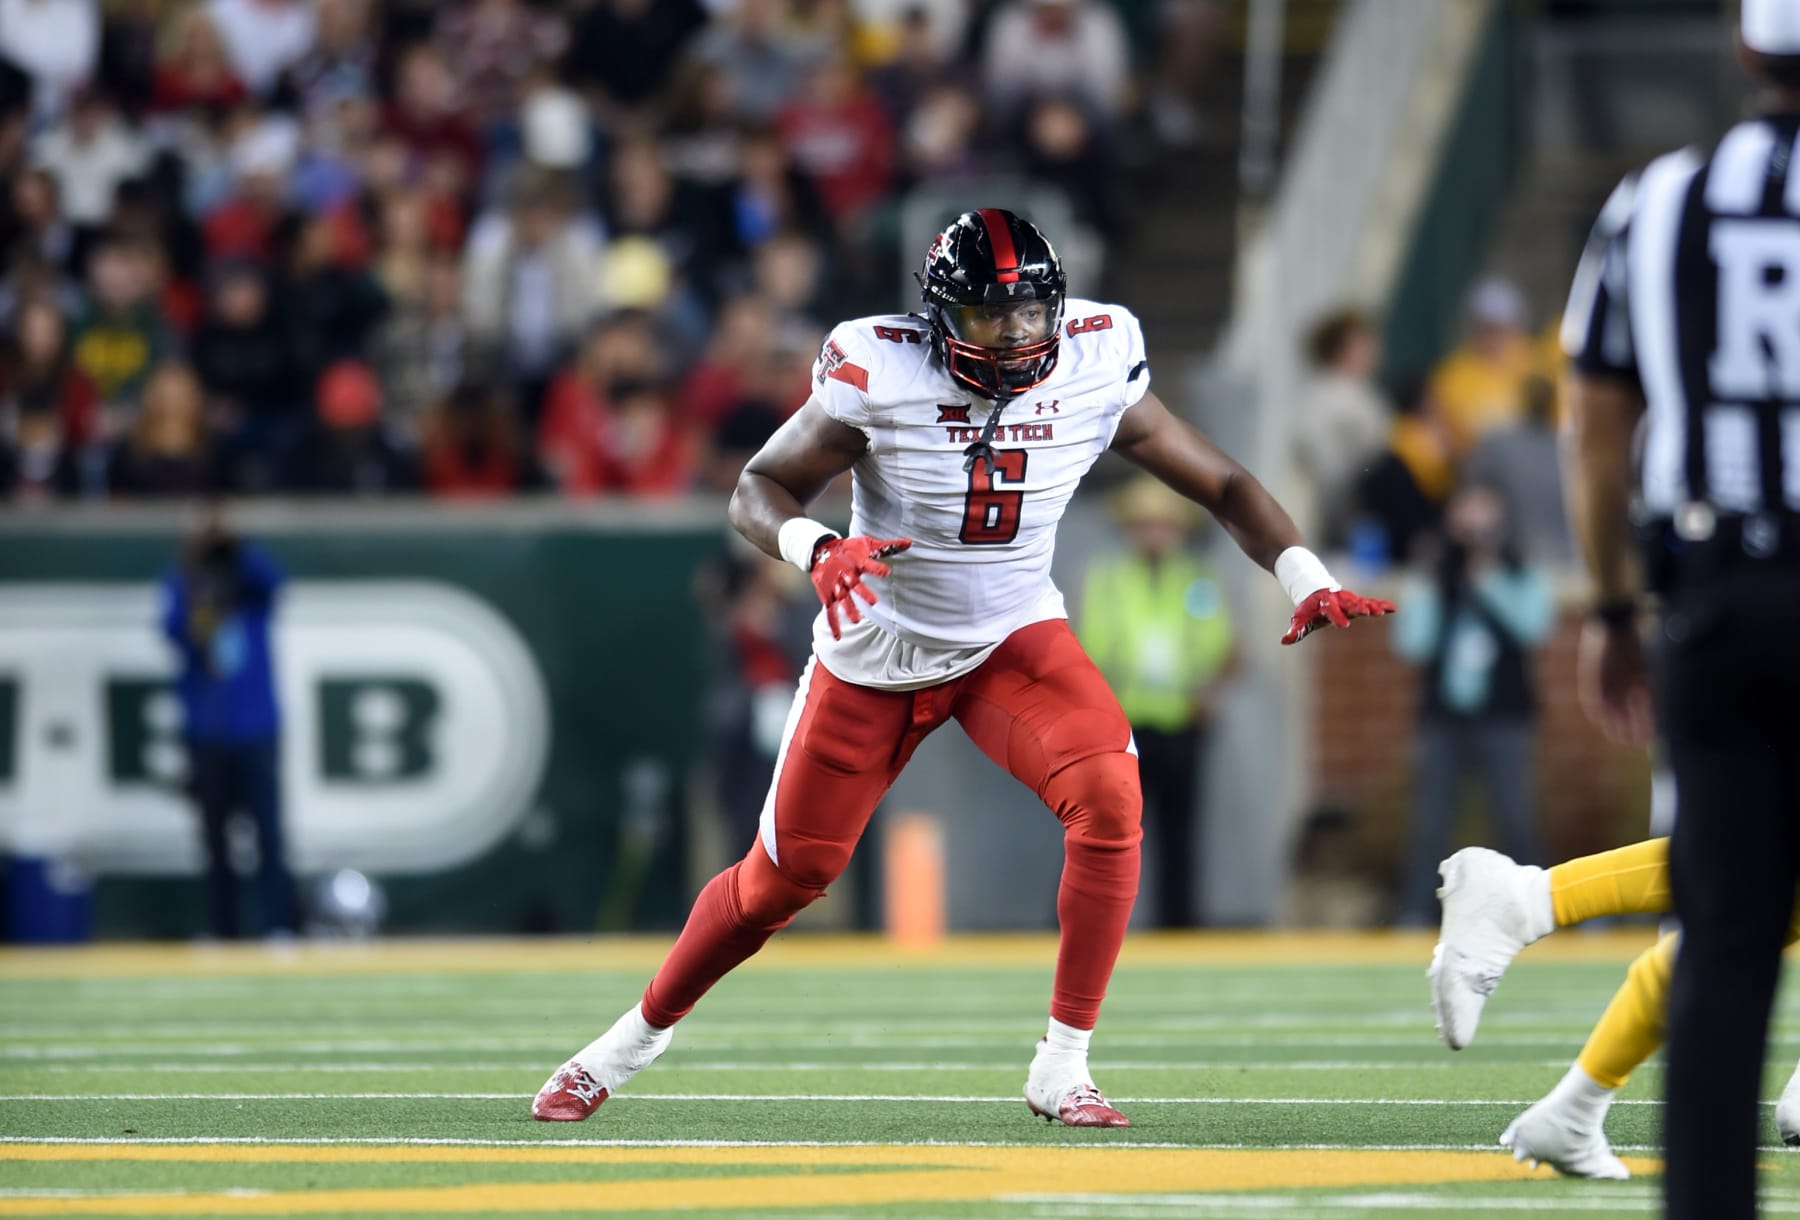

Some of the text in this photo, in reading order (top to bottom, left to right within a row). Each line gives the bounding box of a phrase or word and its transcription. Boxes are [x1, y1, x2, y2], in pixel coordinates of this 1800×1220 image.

[1707, 221, 1800, 399] R
[873, 325, 921, 344] 6
[1066, 314, 1113, 339] 6
[946, 424, 1053, 443] TEXS TECH
[958, 448, 1028, 545] 6
